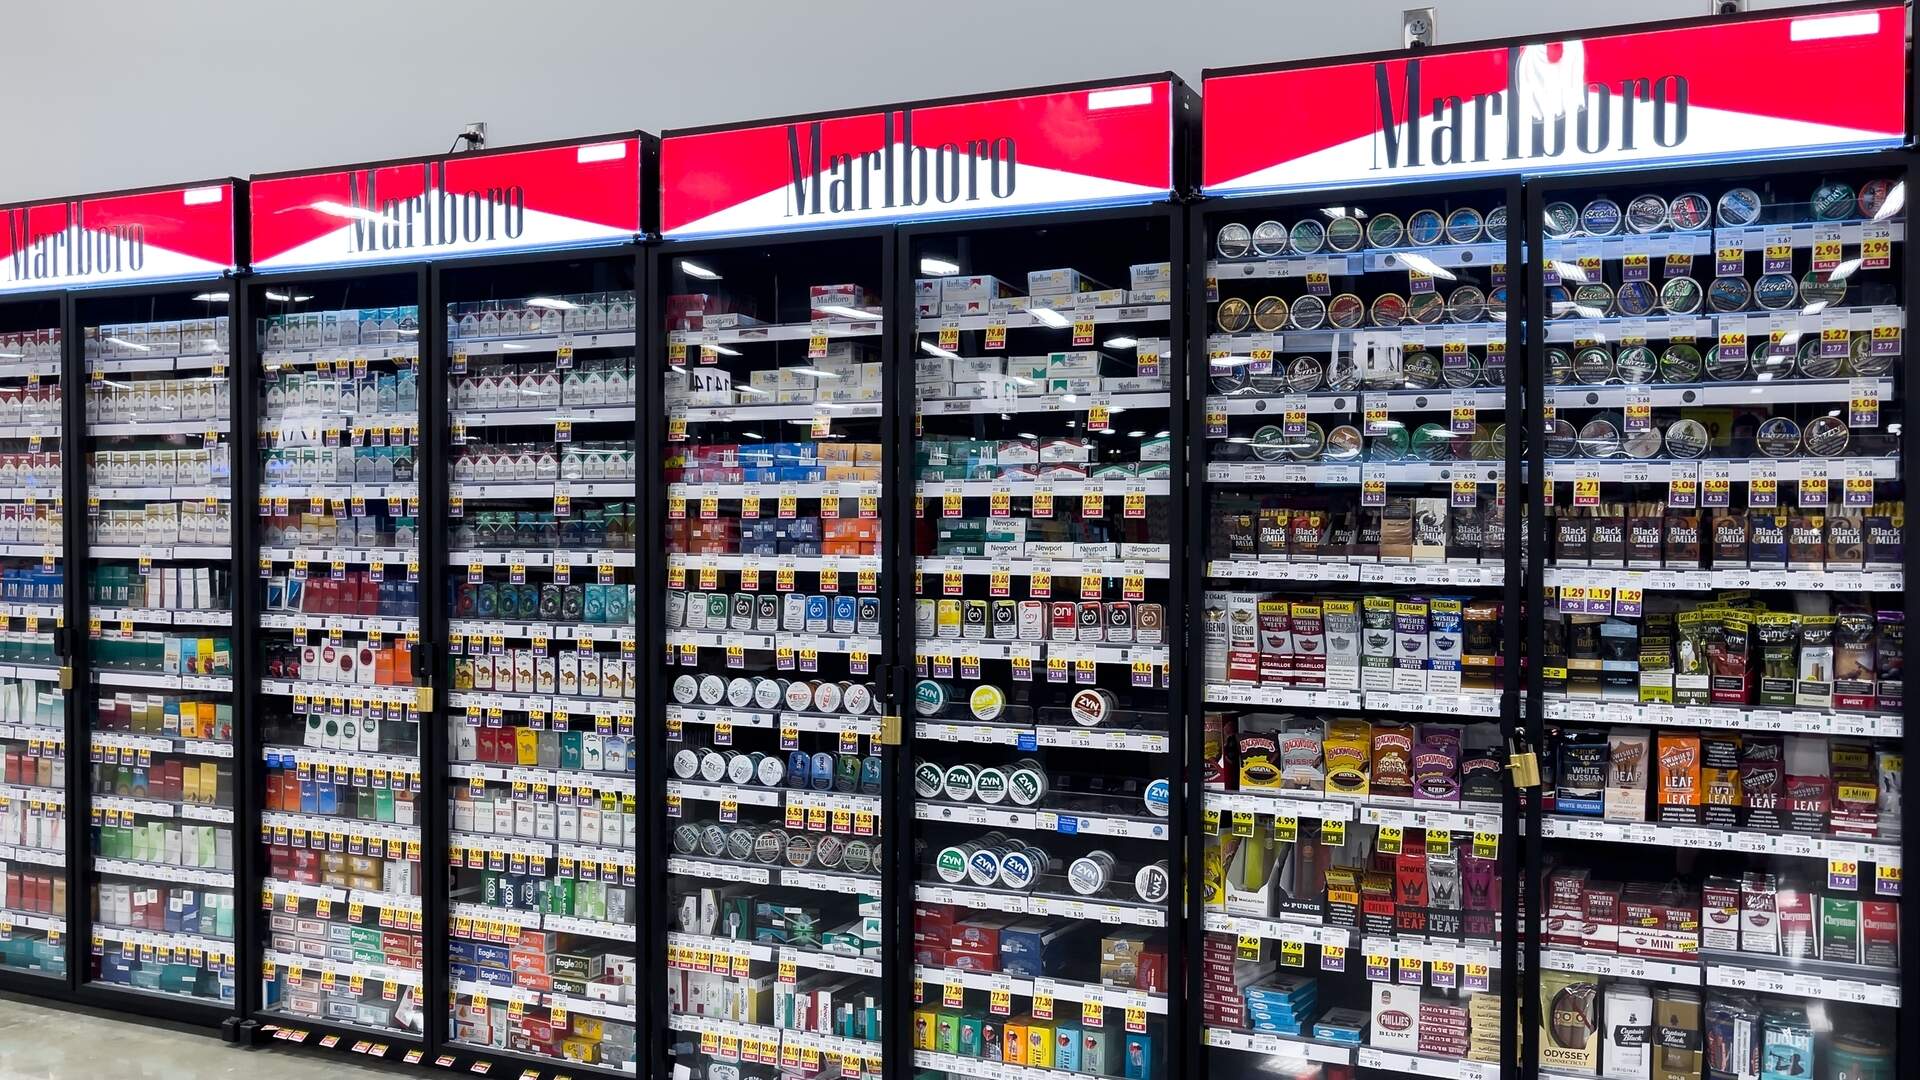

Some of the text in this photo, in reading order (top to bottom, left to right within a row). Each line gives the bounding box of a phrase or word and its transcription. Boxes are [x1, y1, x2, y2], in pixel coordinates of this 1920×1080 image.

[784, 109, 1016, 216] Marlboro
[1819, 188, 1843, 211] HUSKY
[347, 161, 524, 253] Marlboro
[1585, 209, 1617, 220] SKOAL
[7, 202, 144, 282] Marlboro
[1719, 248, 1743, 257] 5.17
[1767, 246, 1790, 255] 5.17
[1815, 244, 1840, 255] 2.96
[1863, 242, 1889, 253] 2.96
[1624, 256, 1648, 266] 6.64
[1308, 273, 1327, 282] 5.67
[816, 296, 849, 304] Marlboro
[987, 328, 1005, 336] 79.80
[1823, 330, 1848, 340] 5.27
[1874, 328, 1899, 338] 5.27
[1720, 334, 1744, 344] 6.64
[1140, 355, 1157, 363] 6.64
[1852, 400, 1877, 409] 5.08
[1453, 408, 1474, 416] 5.08
[1627, 406, 1649, 414] 5.08
[1286, 412, 1306, 420] 5.08
[1364, 481, 1385, 489] 6.62
[1576, 482, 1599, 492] 2.71
[1672, 480, 1695, 489] 5.08
[1752, 480, 1775, 488] 5.08
[1802, 480, 1826, 488] 5.08
[1084, 496, 1102, 504] 72.30
[1420, 525, 1443, 533] Black
[1561, 526, 1586, 536] Black
[1633, 527, 1658, 537] Black
[1718, 527, 1744, 536] Black
[1831, 527, 1859, 536] Black
[1125, 578, 1143, 587] 78.60
[1562, 588, 1584, 598] 1.29
[1588, 589, 1610, 599] 1.19
[1618, 590, 1640, 600] 1.29
[935, 656, 951, 664] 4.16
[1077, 661, 1094, 669] 4.16
[1080, 696, 1099, 710] ZYN
[1240, 738, 1275, 752] BACKWOODS
[1375, 733, 1410, 749] BACKWOODS
[1327, 747, 1364, 760] BACKWOODS
[1416, 753, 1454, 769] BACKWOODS
[950, 773, 969, 782] ZYN
[981, 777, 1000, 785] ZYN
[1666, 776, 1692, 787] LEAF
[1667, 795, 1691, 805] LEAF
[1709, 794, 1736, 805] LEAF
[1750, 798, 1777, 809] LEAF
[1794, 801, 1821, 811] LEAF
[787, 808, 802, 816] 6.53
[1234, 813, 1252, 821] 4.99
[1323, 820, 1342, 829] 4.99
[1475, 832, 1496, 842] 4.99
[943, 855, 962, 865] ZYN
[1008, 857, 1026, 872] ZYN
[1831, 862, 1856, 873] 1.89
[487, 877, 495, 902] KOOL
[1291, 902, 1320, 911] PUNCH
[1430, 914, 1458, 924] NATURAL
[1781, 912, 1811, 922] Cheyenne
[1824, 916, 1856, 927] Cheyenne
[1430, 921, 1458, 933] LEAF
[1239, 937, 1258, 946] 9.49
[1651, 939, 1673, 949] MINI
[1324, 947, 1343, 956] 1.79
[1368, 956, 1389, 966] 1.79
[780, 964, 795, 972] 72.30
[1466, 964, 1487, 974] 1.59
[1084, 1004, 1101, 1013] 77.30
[1380, 1015, 1410, 1027] PHILLIES
[1621, 1028, 1644, 1036] Captain
[1624, 1034, 1642, 1042] Black
[1544, 1050, 1590, 1060] ODYSSEY
